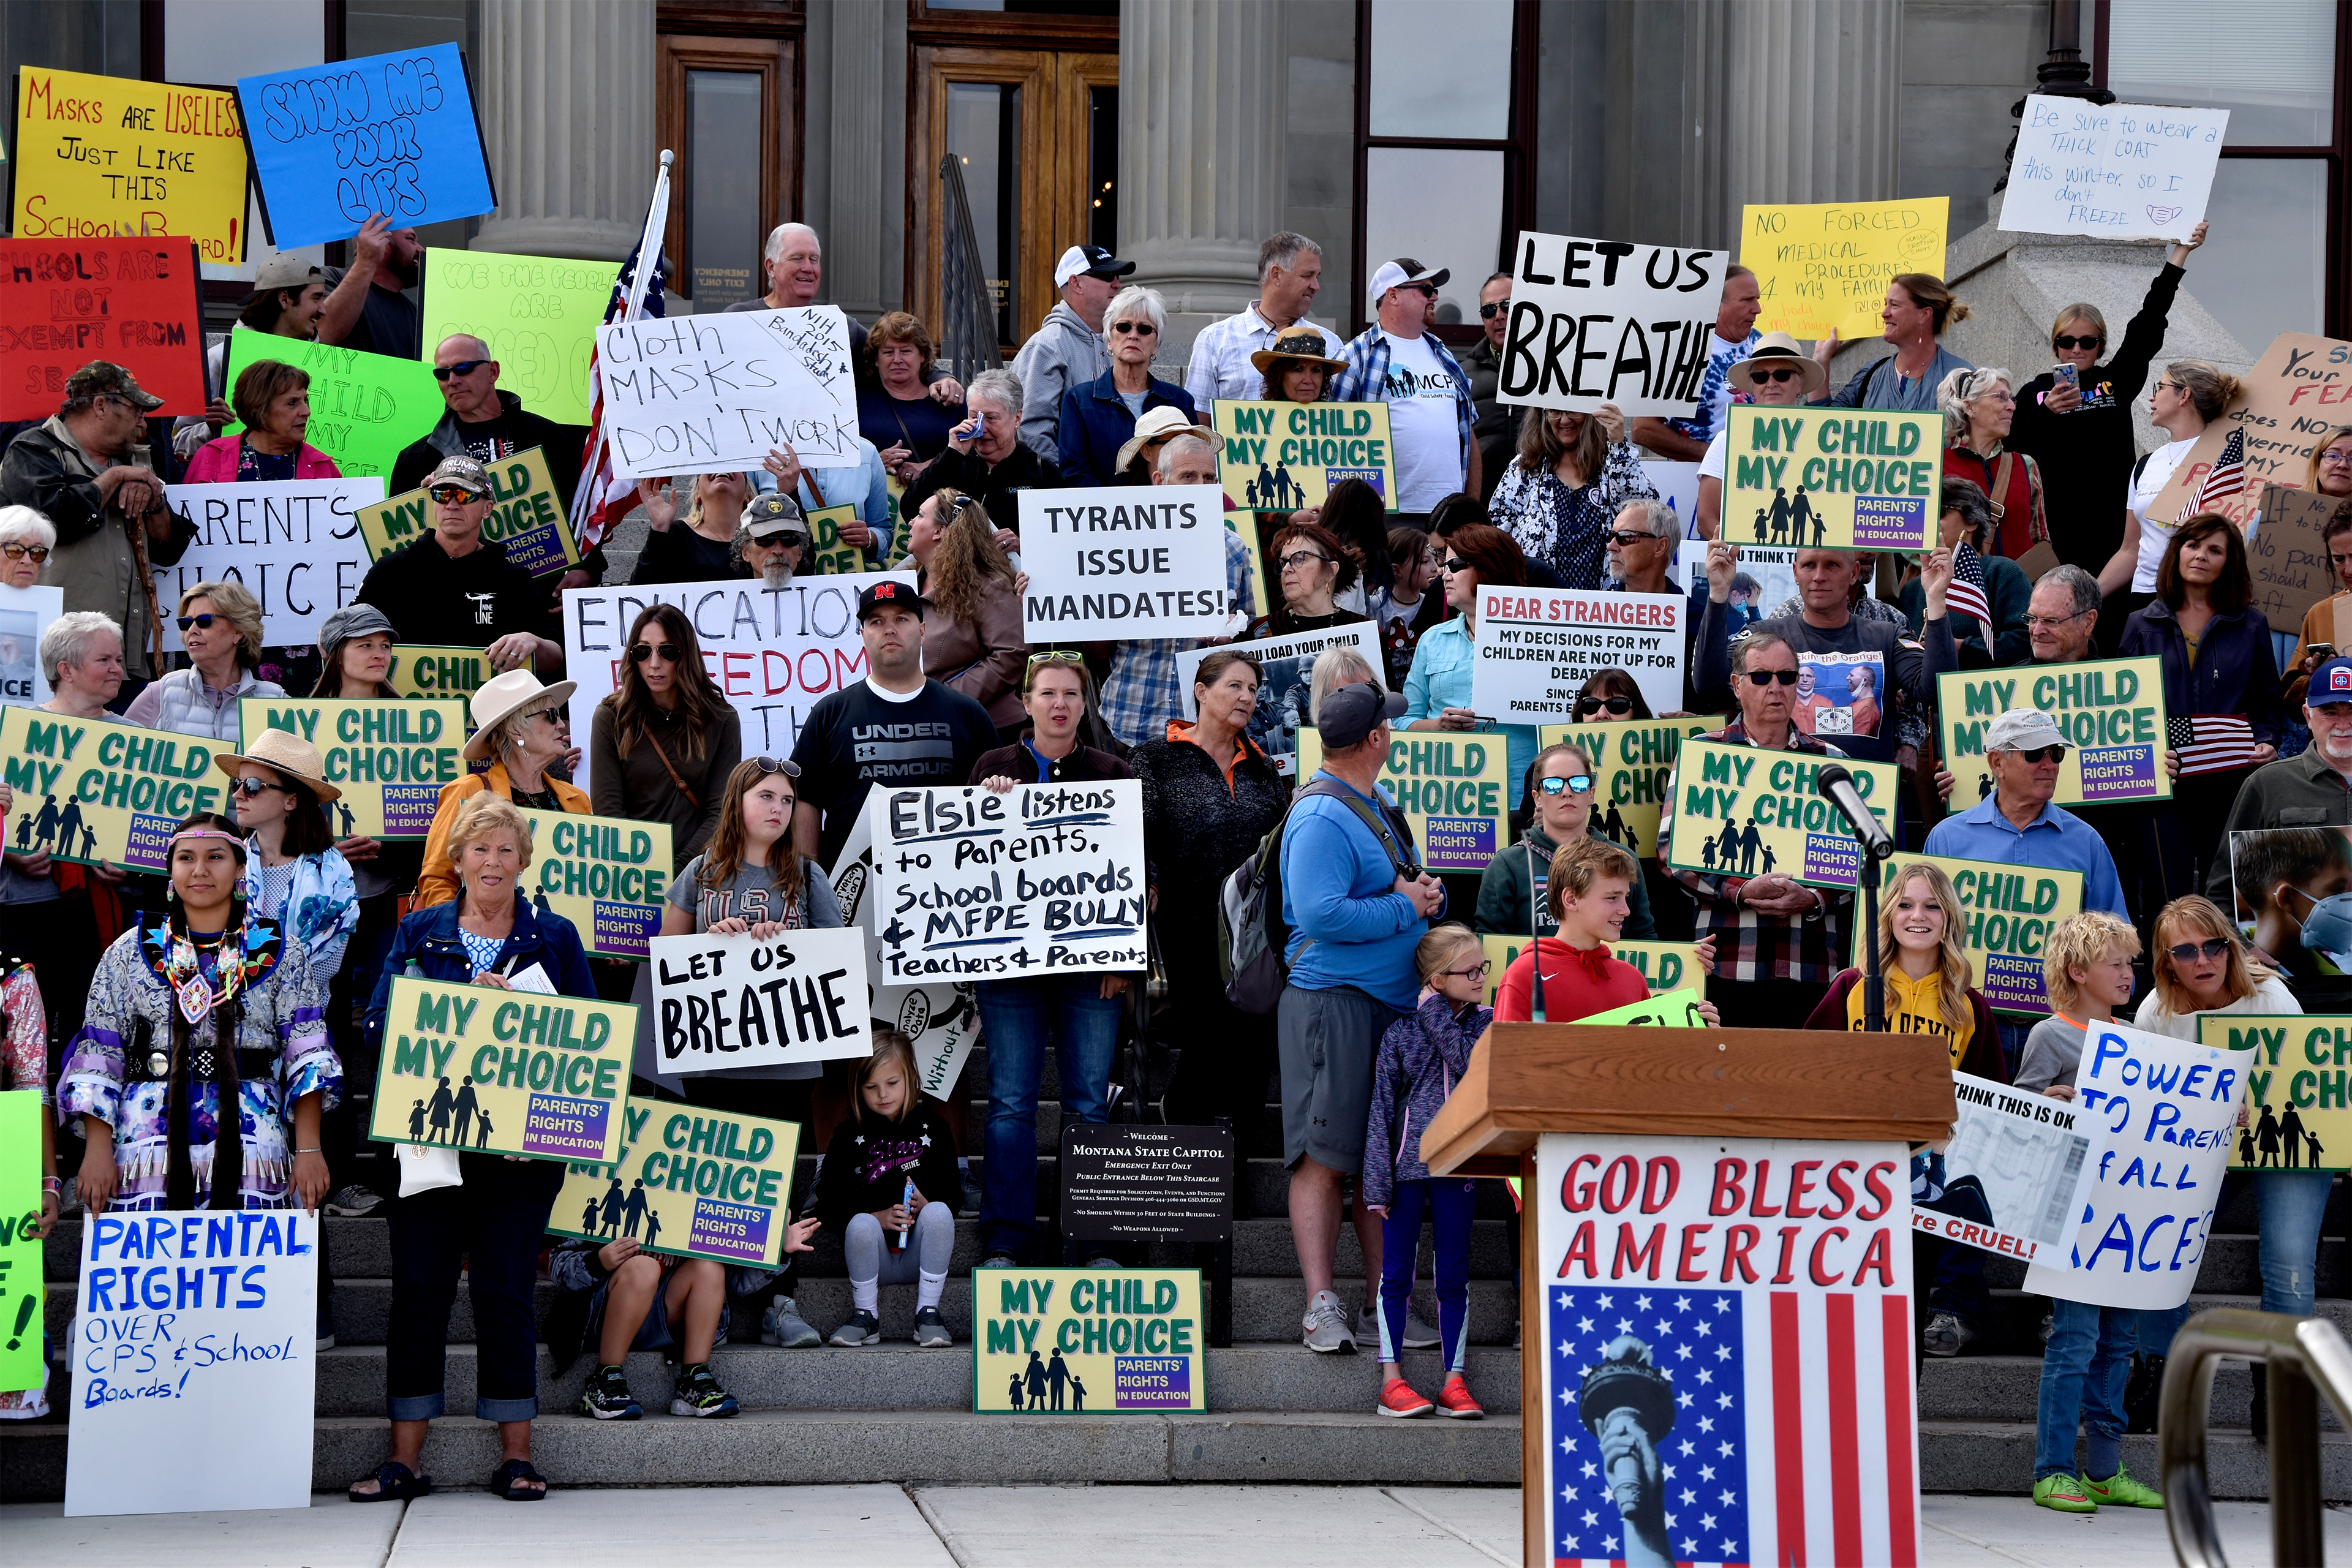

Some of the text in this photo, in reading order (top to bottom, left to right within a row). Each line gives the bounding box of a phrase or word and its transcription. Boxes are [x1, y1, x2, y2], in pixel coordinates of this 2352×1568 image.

[261, 58, 443, 142] SHOW ME
[123, 106, 155, 131] ARE
[2030, 103, 2216, 141] Be sure to wear a
[57, 137, 194, 173] JUST LIKE
[333, 118, 422, 169] YOUR
[2051, 132, 2159, 159] THICK COAT
[102, 174, 167, 200] THIS
[2022, 156, 2183, 191] this so I
[337, 162, 426, 222] LIPS
[2055, 185, 2095, 202] don't
[1756, 209, 1920, 235] NO FORCED
[2069, 205, 2129, 225] FREEZE
[1777, 242, 1867, 262] MEDICAL
[1906, 233, 1928, 242] MASKS
[1907, 238, 1936, 249] TESTING
[1523, 239, 1713, 292] LET US
[1804, 261, 1913, 279] PROCEDURES
[50, 287, 111, 317] NOT
[1782, 303, 1814, 318] body
[119, 321, 186, 348] FROM
[801, 309, 836, 333] NIH
[1798, 321, 1831, 331] choice
[607, 320, 723, 363] Cloth
[807, 324, 844, 352] 2015
[1502, 301, 1716, 403] BREATHE
[610, 359, 777, 405] MASKS
[801, 356, 836, 387] Study
[761, 414, 859, 453] WORK
[1752, 417, 1920, 457] MY CHILD
[442, 458, 480, 472] TRUMP
[470, 448, 484, 457] 1776
[1736, 454, 1932, 496] MY CHOICE
[1044, 503, 1197, 533] TYRANTS
[1856, 514, 1904, 527] RIGHTS
[1854, 530, 1922, 541] IN EDUCATION
[1077, 548, 1170, 576] ISSUE
[476, 612, 492, 624] LINE
[1027, 590, 1224, 622] MANDATES!
[1487, 595, 1676, 627] DEAR STRANGERS
[1266, 639, 1324, 660] LOAD YOUR
[1499, 630, 1660, 650] MY DECISIONS FOR MY
[1483, 646, 1675, 668] CHILDREN ARE NOT UP FOR
[1841, 651, 1882, 662] Orange!
[853, 722, 951, 741] UNDER
[859, 762, 953, 779] ARMOUR
[890, 788, 1115, 839] Elsie listens
[896, 826, 1099, 872] to Parents.
[896, 859, 1133, 914] School boards
[924, 894, 1145, 943] MFPE BULLY
[659, 944, 796, 986] LET US
[886, 946, 1146, 976] Teachers Parents
[662, 968, 859, 1059] BREATHE
[924, 1025, 961, 1091] Without
[2090, 1032, 2235, 1103] POWER
[1997, 1094, 2076, 1130] THIS IS OK
[1561, 1154, 1898, 1221] GOD BLESS
[2119, 1156, 2197, 1191] ALL
[91, 1211, 312, 1261] PARENTAL
[1945, 1219, 2037, 1259] CRUEL!
[1558, 1219, 1894, 1287] AMERICA
[88, 1265, 266, 1312] RIGHTS
[1001, 1279, 1177, 1314] MY CHILD
[86, 1314, 175, 1343] OVER
[987, 1319, 1193, 1354] MY CHOICE
[86, 1344, 156, 1373] CPS
[85, 1367, 190, 1409] Boards!
[1117, 1391, 1189, 1400] IN EDUCATION
[1118, 1376, 1169, 1387] RIGHTS
